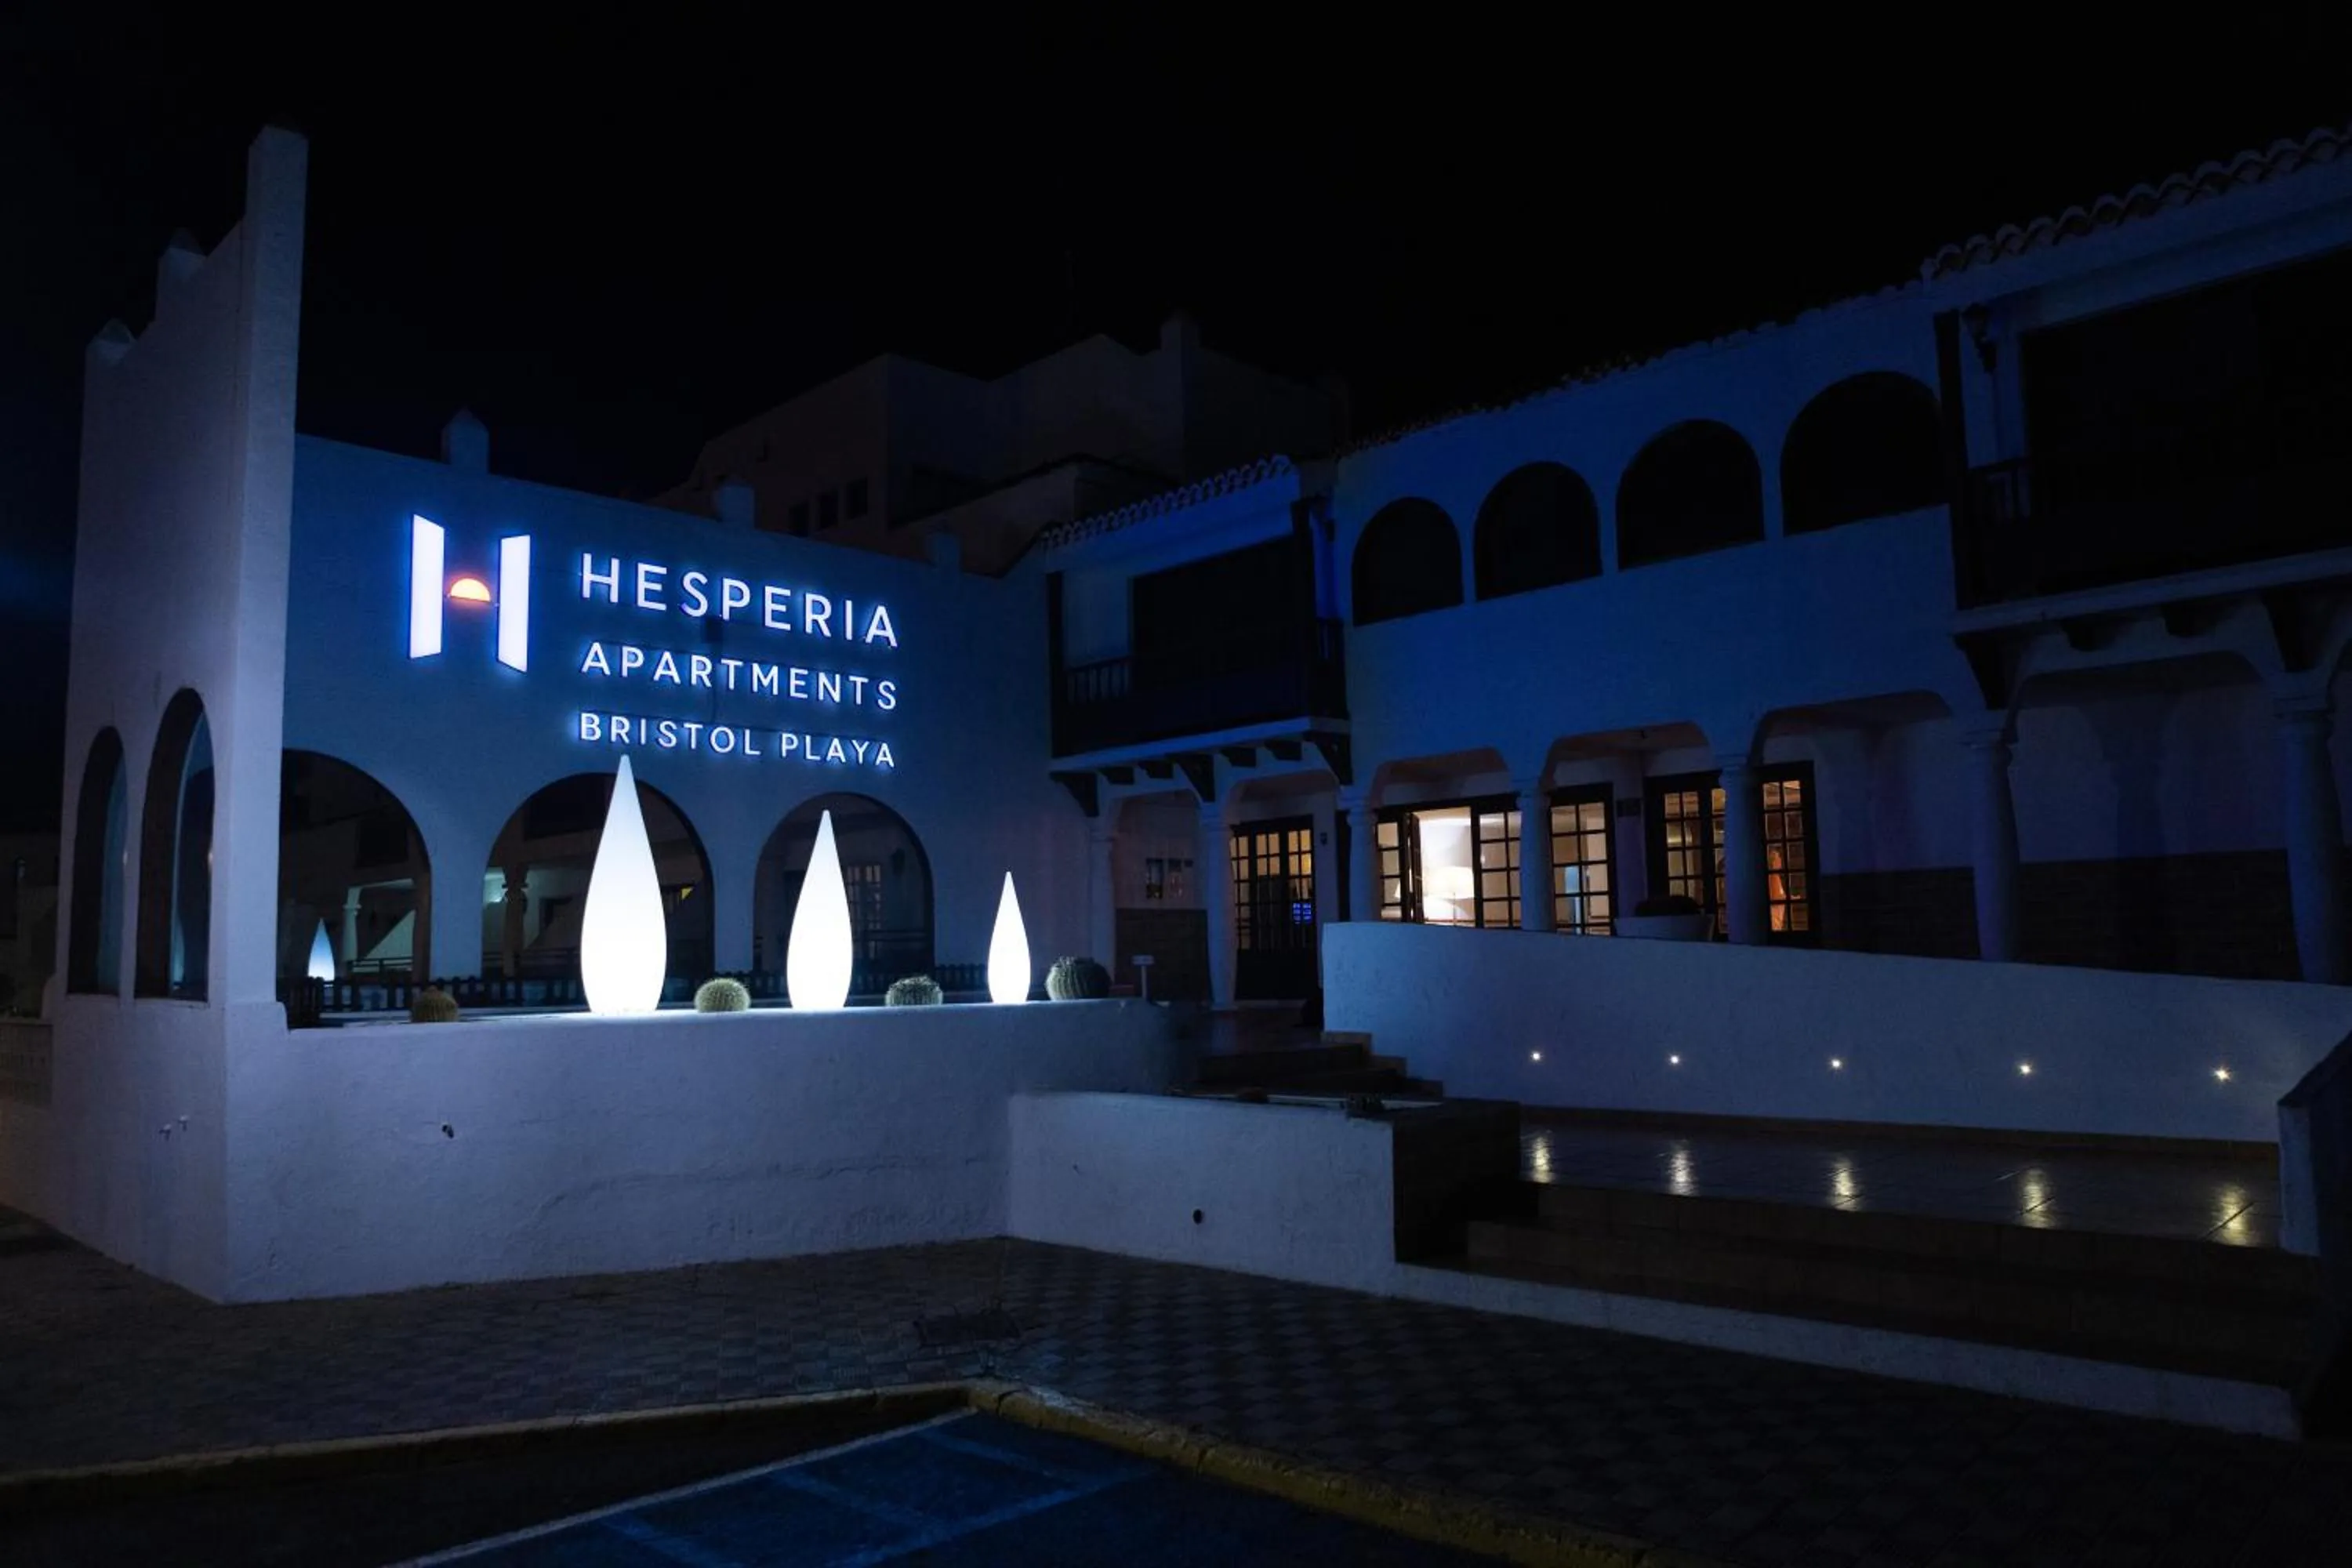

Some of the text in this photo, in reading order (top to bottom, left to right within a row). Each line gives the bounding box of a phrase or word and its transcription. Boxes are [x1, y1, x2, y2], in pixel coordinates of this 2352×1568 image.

[582, 553, 898, 647] HESPERIA
[581, 642, 896, 710] APARTMENTS
[580, 712, 895, 768] BRISTOL PLAYA
